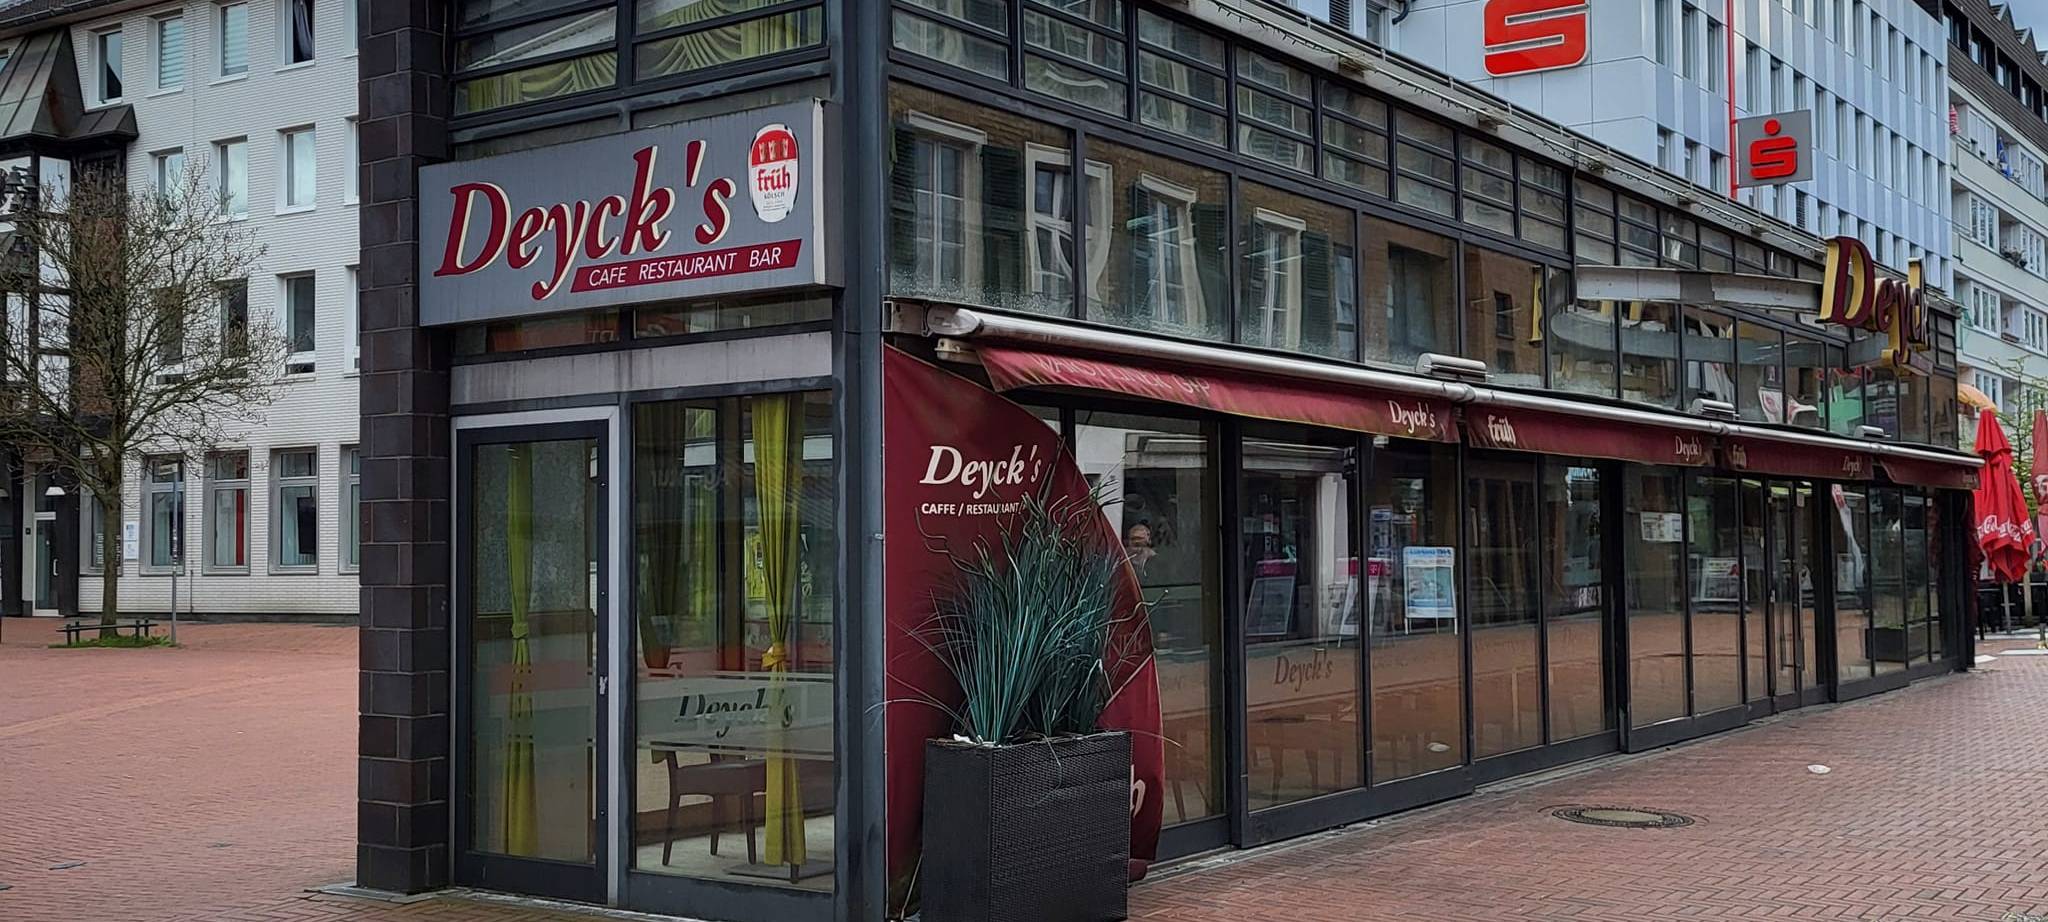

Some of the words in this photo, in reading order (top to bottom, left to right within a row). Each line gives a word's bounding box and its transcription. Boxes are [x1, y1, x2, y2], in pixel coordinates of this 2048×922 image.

[757, 164, 790, 192] früh
[434, 140, 737, 301] Deyck's
[589, 266, 628, 287] CAFE
[639, 252, 738, 281] RESTAURANT
[750, 247, 781, 268] BAR
[1388, 400, 1437, 434] Deyck's
[1487, 414, 1517, 445] früh
[919, 444, 1042, 500] Deyck's
[921, 502, 956, 515] CAFFE
[1274, 649, 1334, 692] Deyck's
